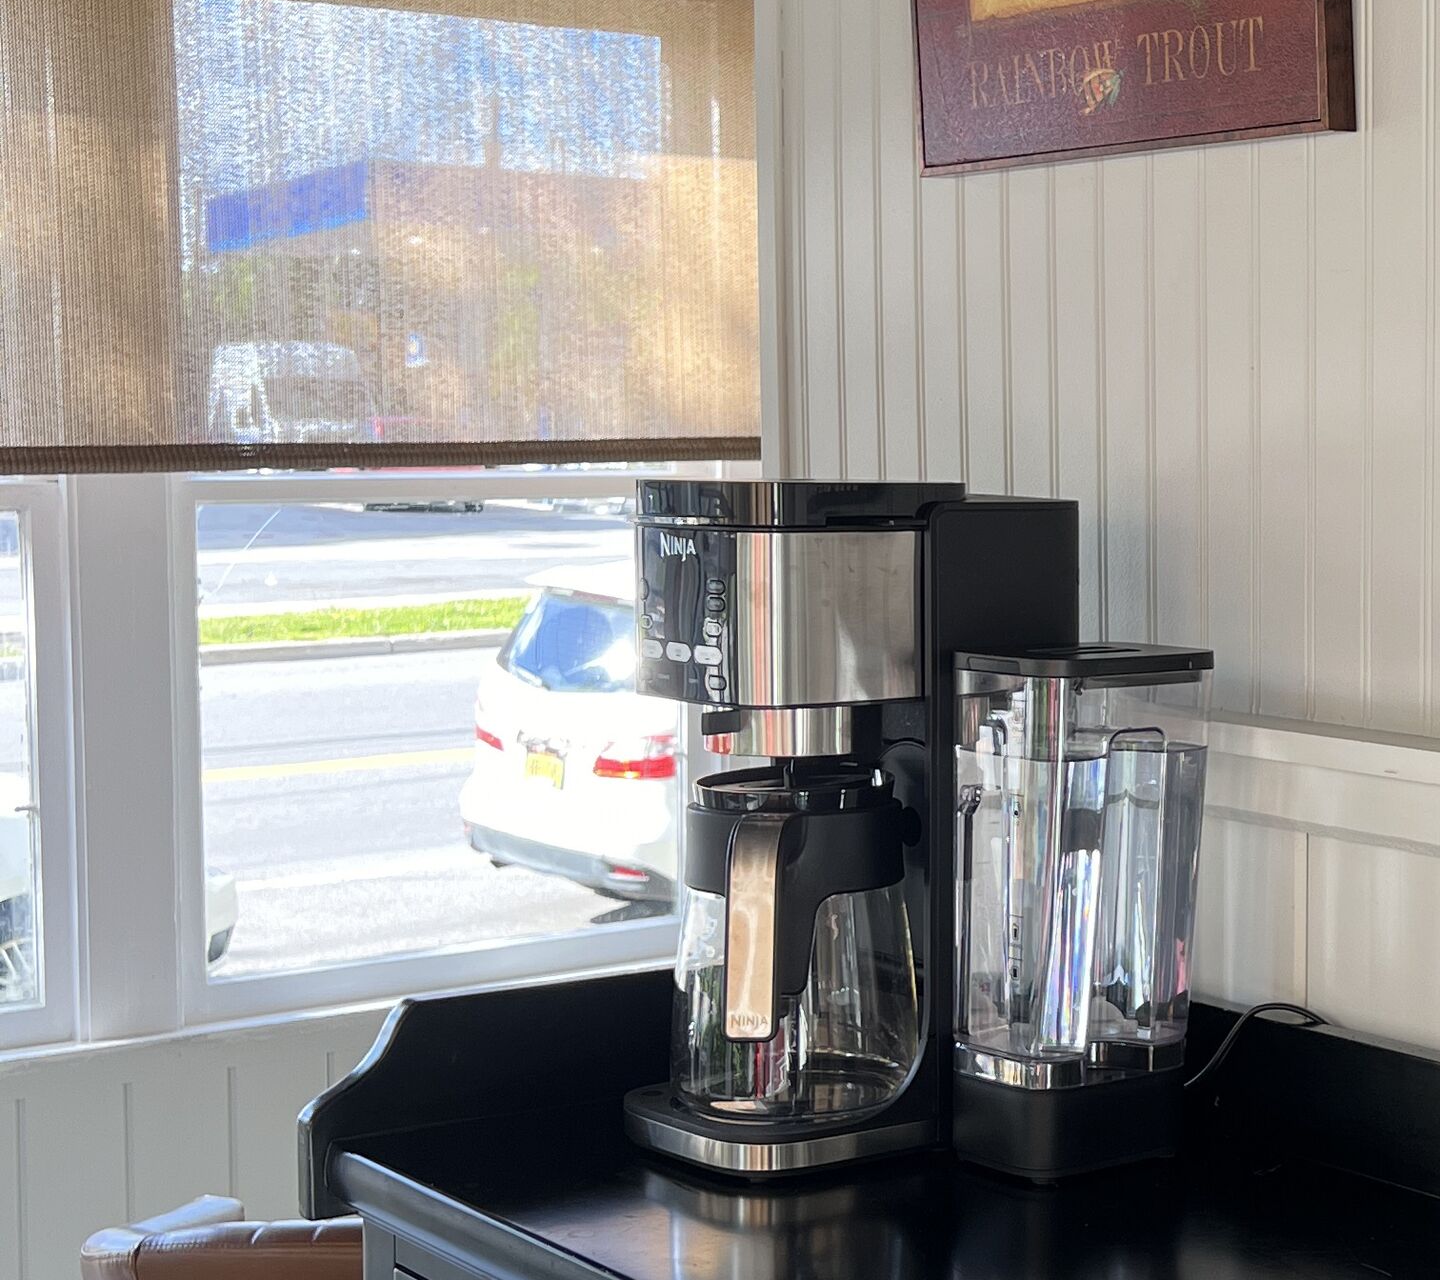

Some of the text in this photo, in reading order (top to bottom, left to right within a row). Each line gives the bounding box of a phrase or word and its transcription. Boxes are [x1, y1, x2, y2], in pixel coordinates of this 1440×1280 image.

[1136, 16, 1264, 85] TROUT
[659, 531, 697, 562] NINJA
[730, 1013, 769, 1030] NINJA
